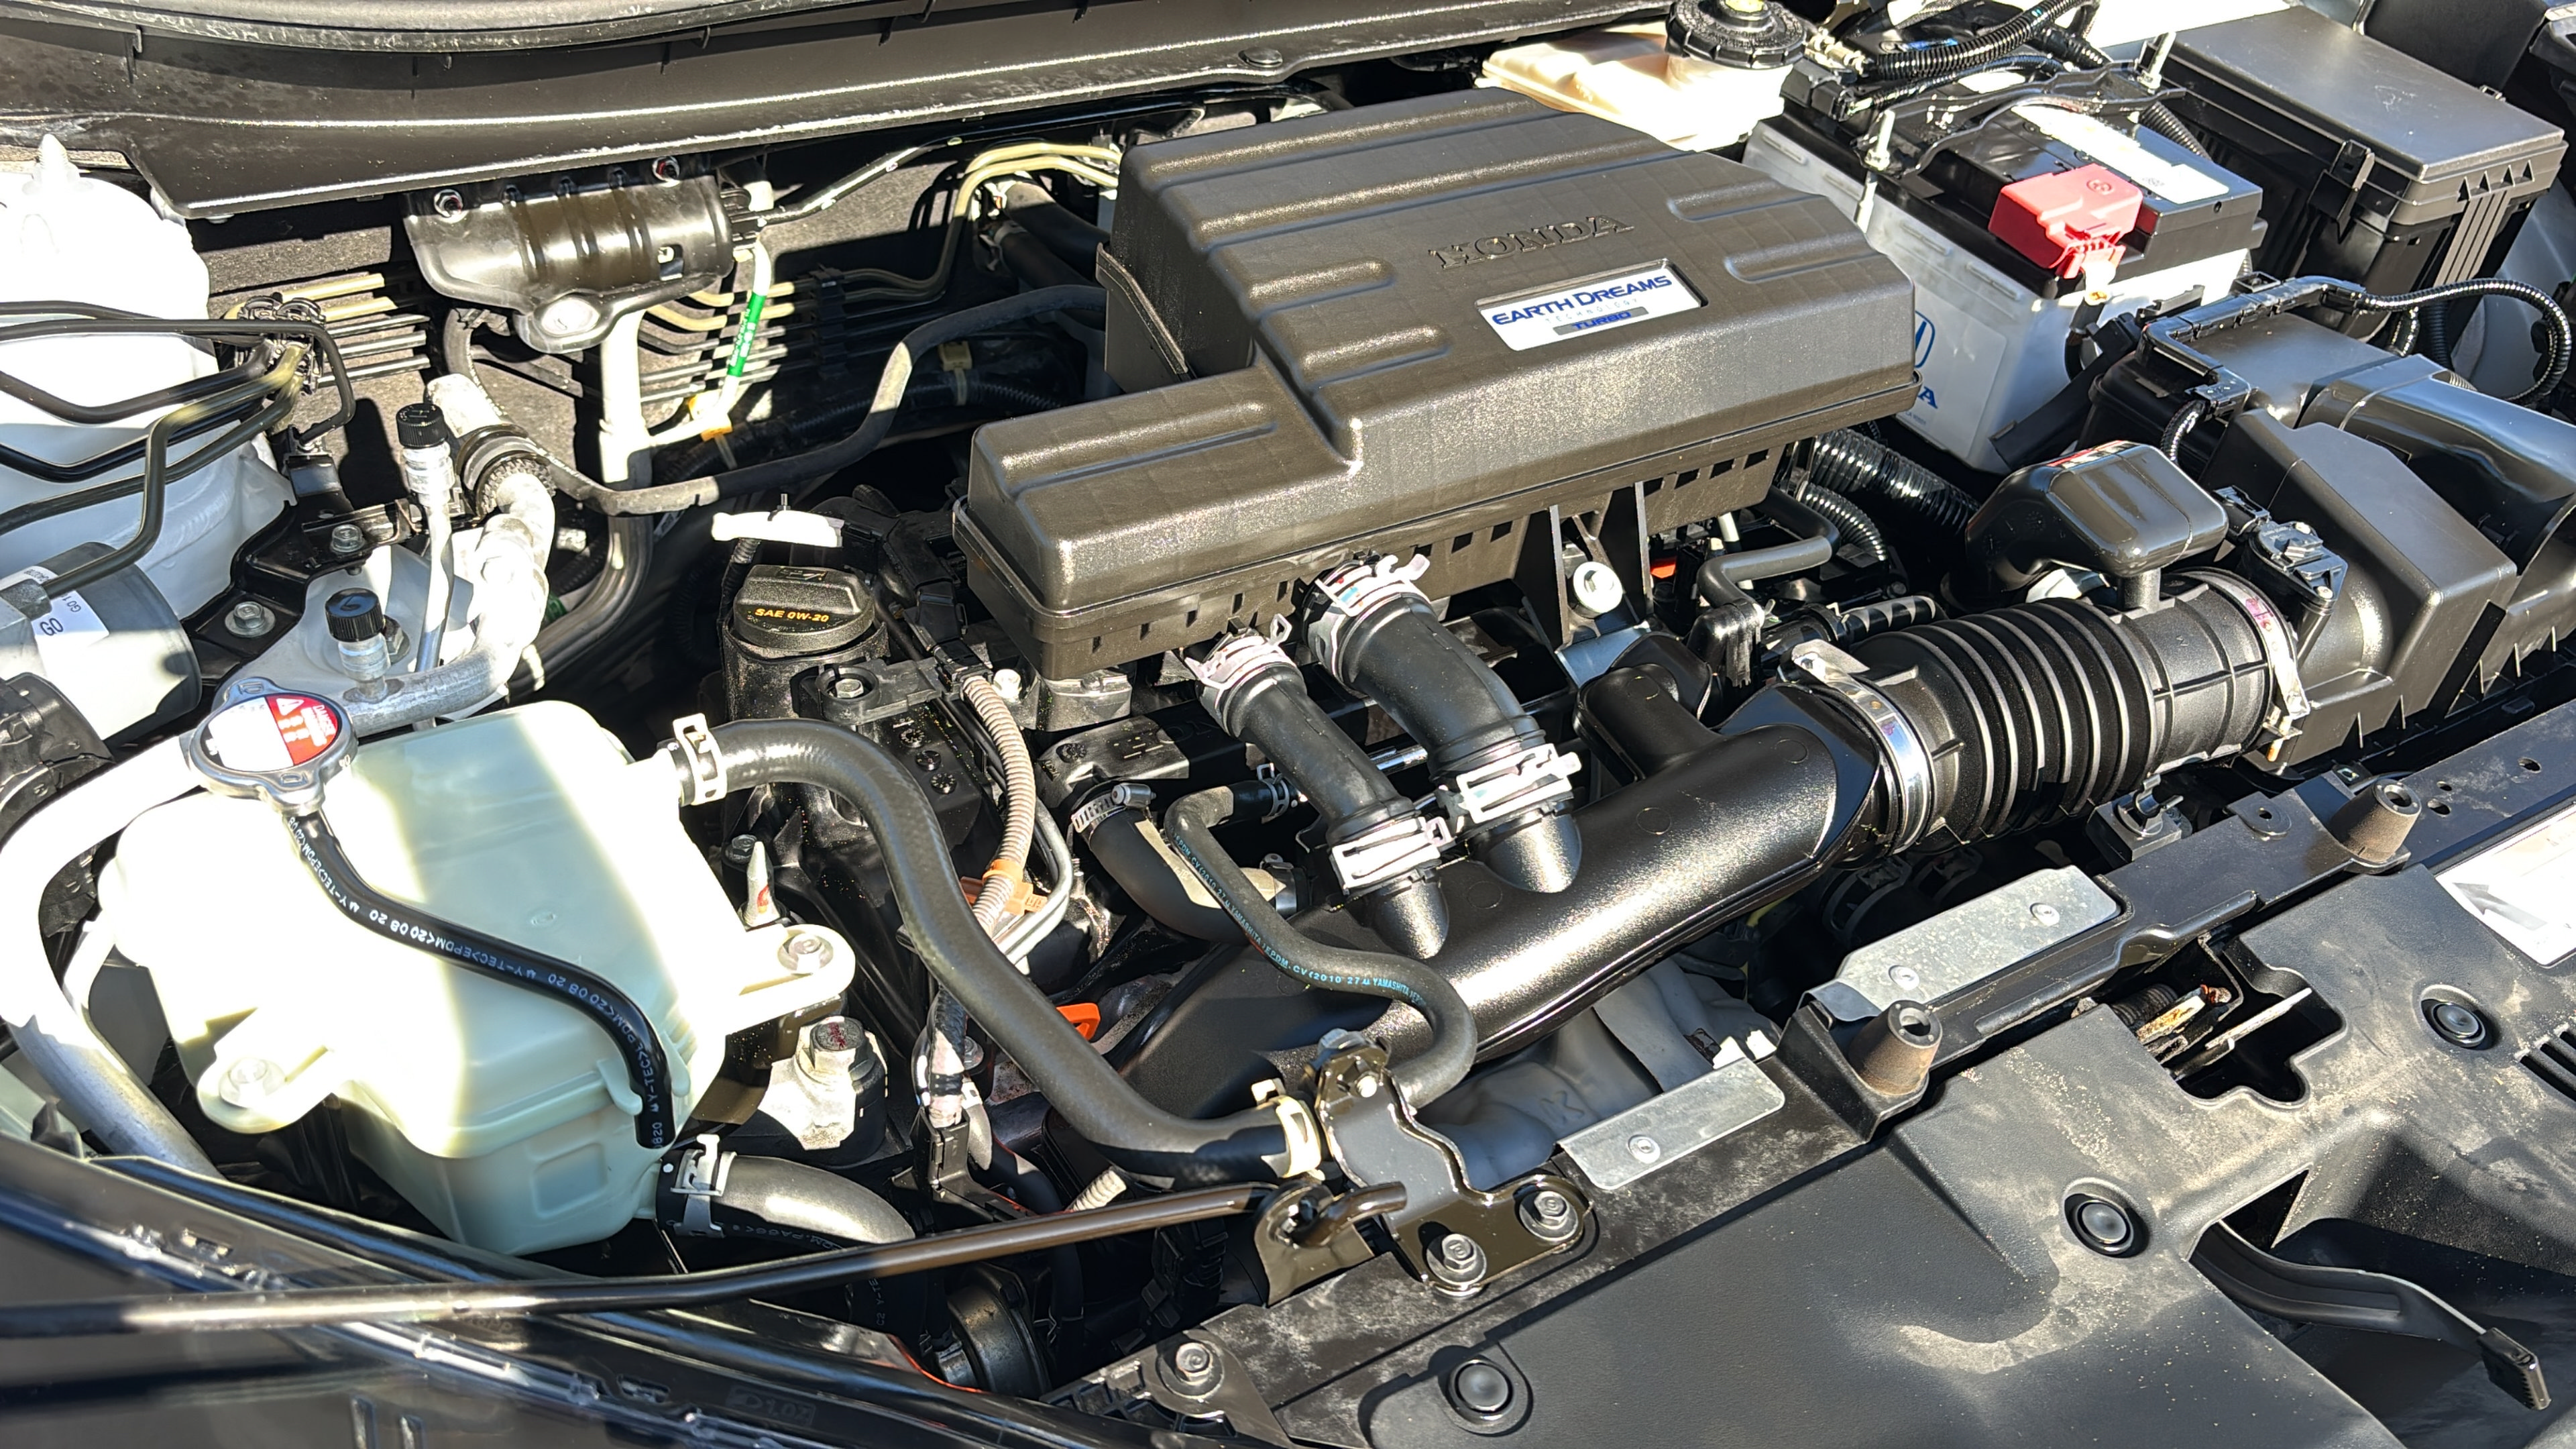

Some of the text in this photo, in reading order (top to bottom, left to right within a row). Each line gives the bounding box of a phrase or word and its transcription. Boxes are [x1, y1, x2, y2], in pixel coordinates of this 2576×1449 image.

[1428, 214, 1635, 268] HONDA
[1492, 274, 1673, 327] EARTH DREAMS
[1571, 310, 1633, 331] TURBO
[754, 608, 830, 623] SAE 0W-20
[1372, 977, 1410, 996] YAMASHITA
